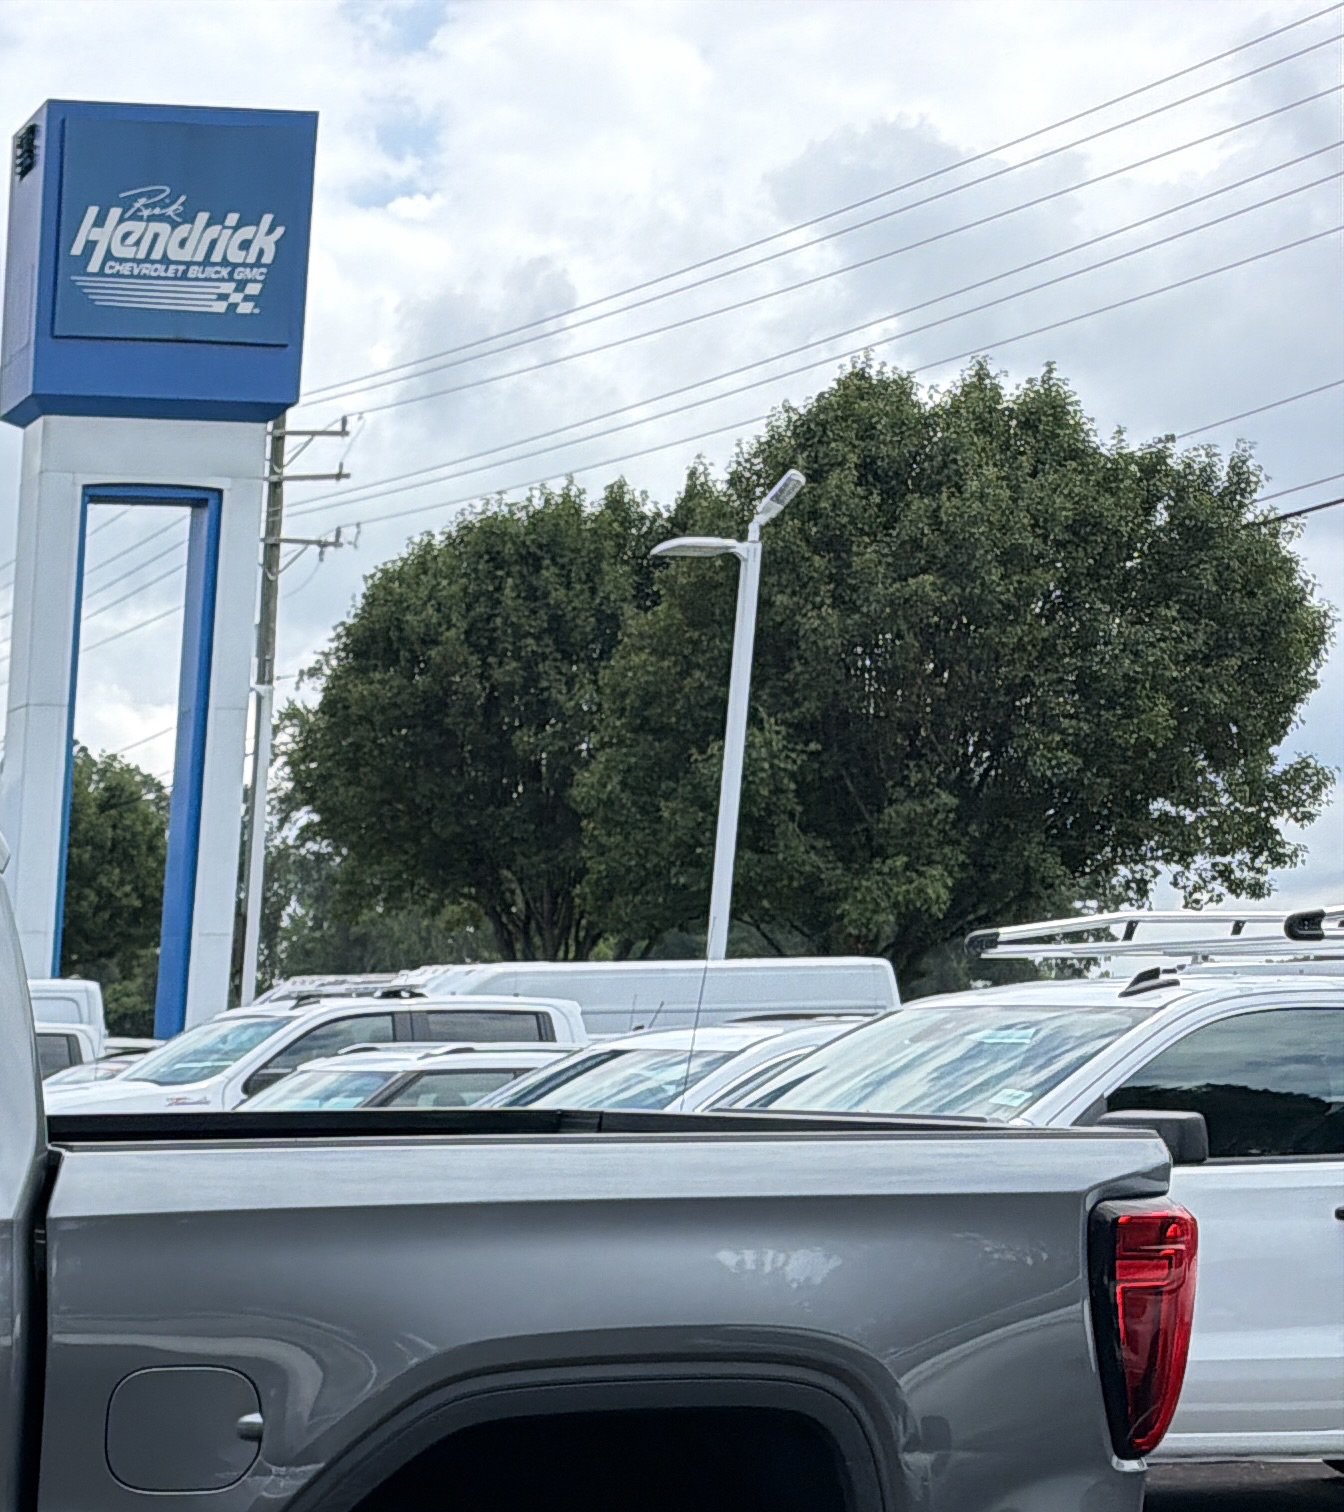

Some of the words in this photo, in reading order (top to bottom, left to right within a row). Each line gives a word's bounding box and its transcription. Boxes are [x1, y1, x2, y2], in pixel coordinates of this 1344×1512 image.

[70, 205, 286, 273] Hendrick
[104, 260, 185, 278] CHEVROLET
[187, 265, 229, 280] BUICK
[233, 268, 268, 281] GMC
